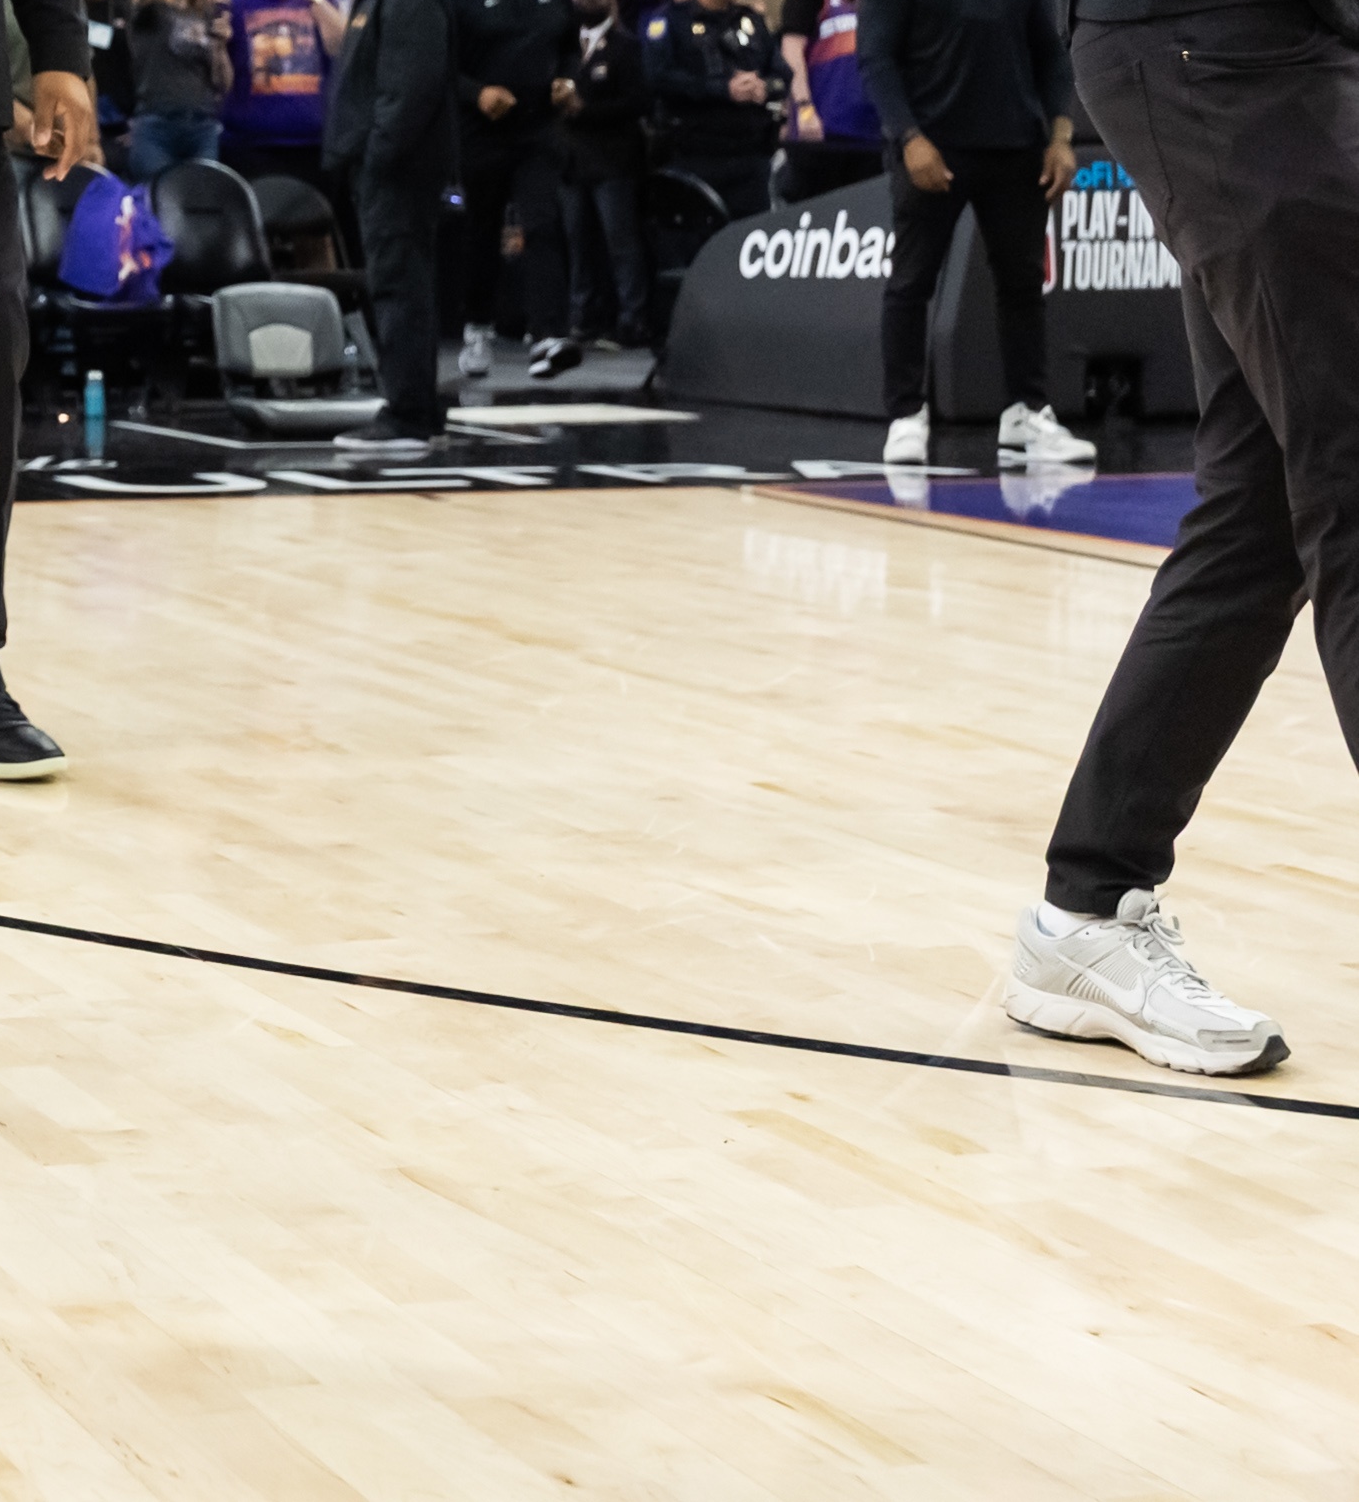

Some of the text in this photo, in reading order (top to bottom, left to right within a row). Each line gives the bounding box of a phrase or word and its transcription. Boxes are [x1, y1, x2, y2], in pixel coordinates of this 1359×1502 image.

[1071, 160, 1113, 190] oFi
[1061, 189, 1155, 240] PLAY-IN
[1060, 238, 1182, 291] TOURNAM
